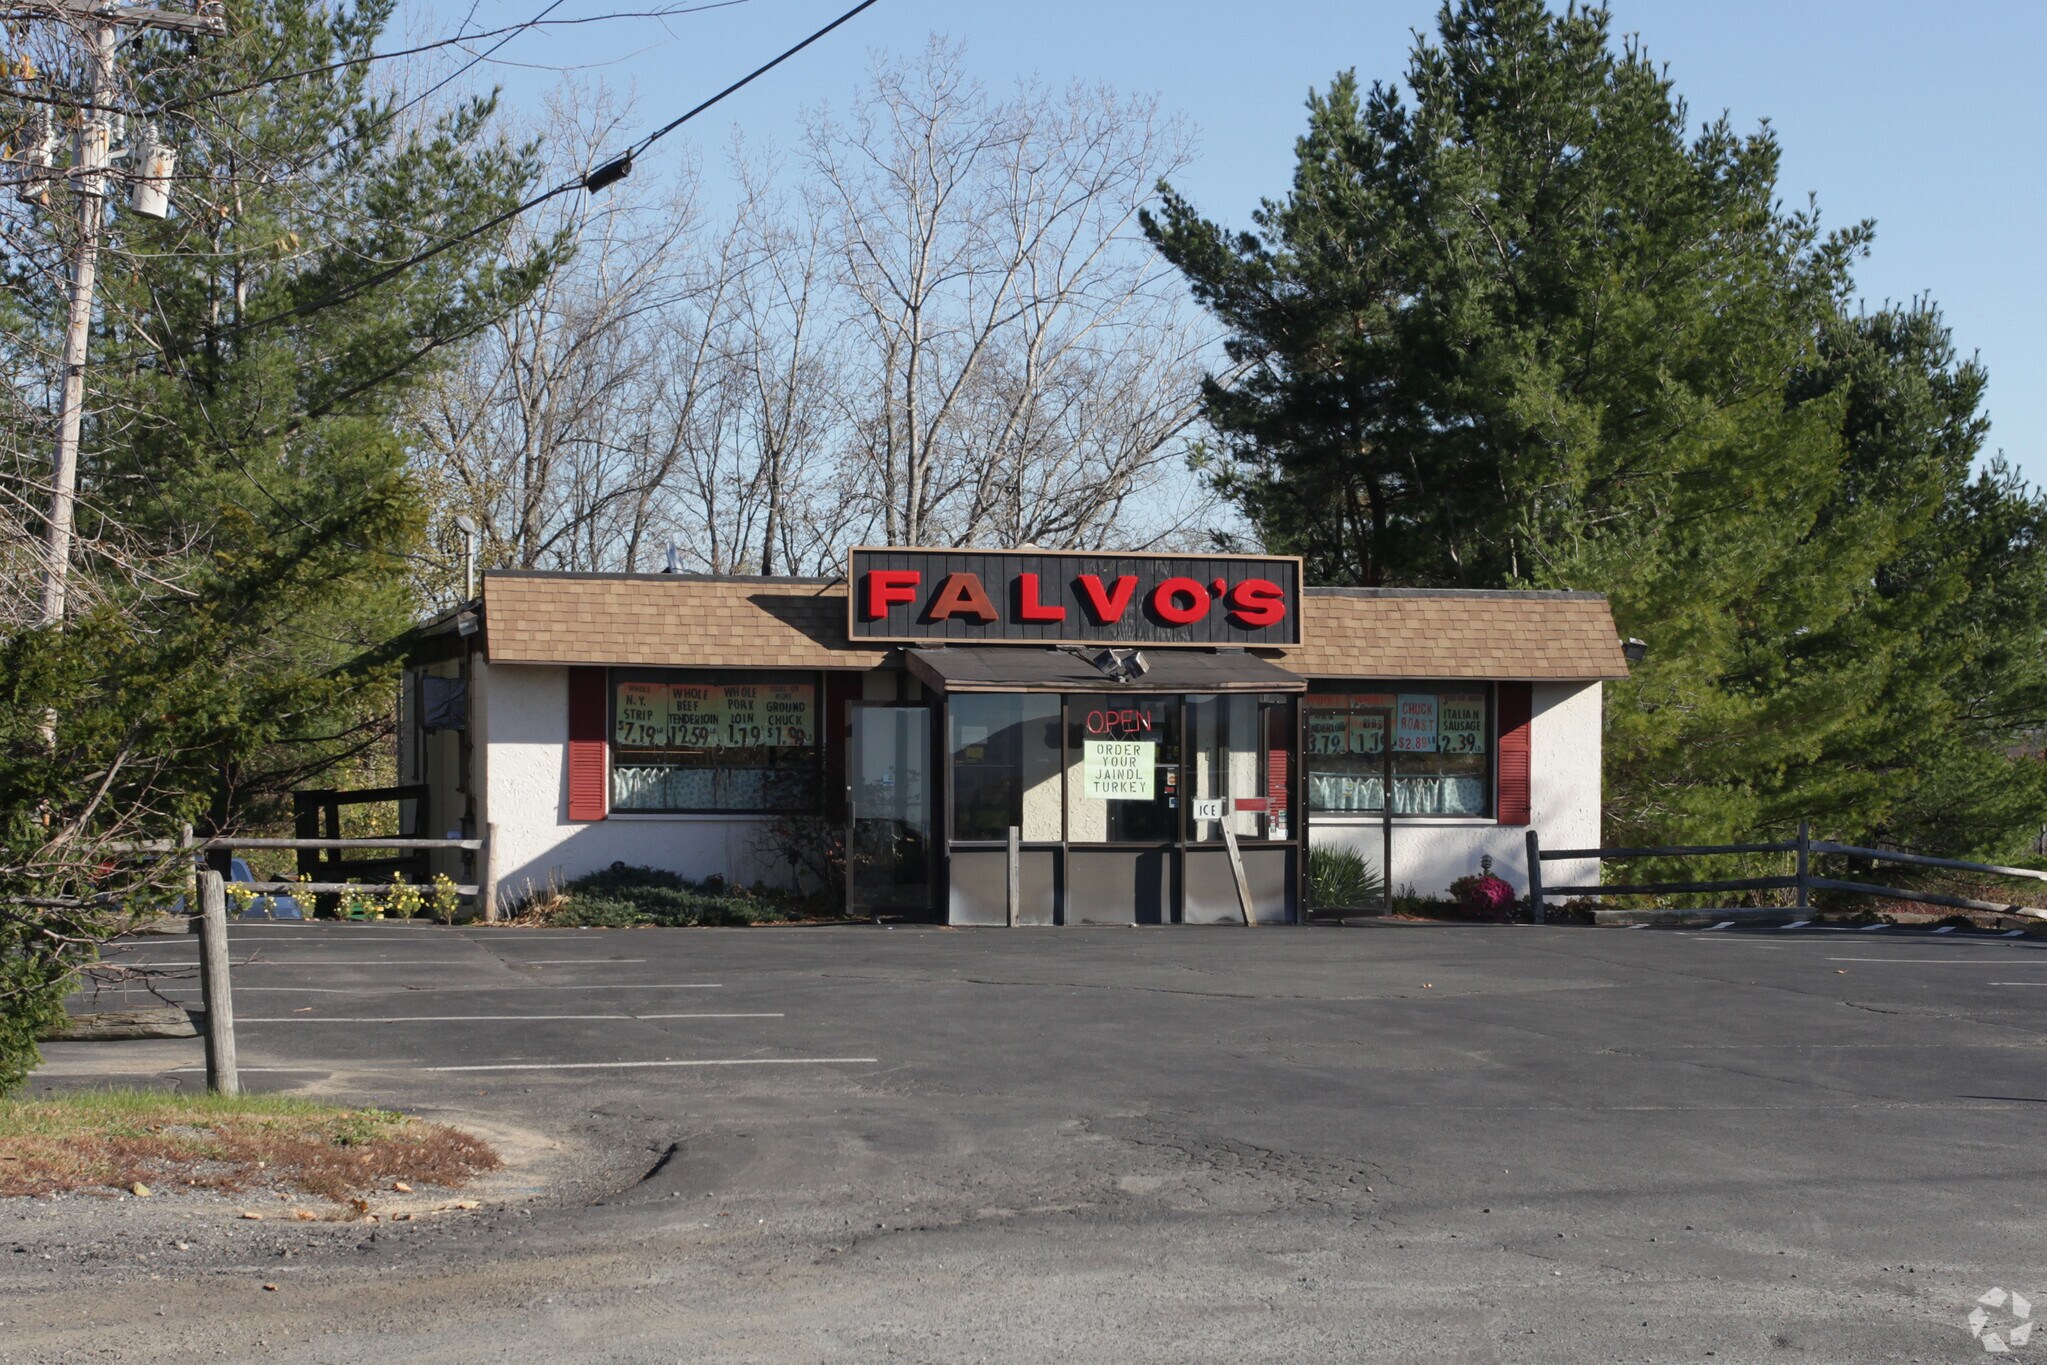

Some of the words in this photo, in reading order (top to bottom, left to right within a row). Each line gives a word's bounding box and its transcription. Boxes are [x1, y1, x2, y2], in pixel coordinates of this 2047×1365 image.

[868, 569, 1286, 627] FALVO'S
[672, 688, 708, 700] WHOLE
[724, 687, 758, 698] WHOLE
[676, 700, 698, 712] BEEF
[728, 699, 754, 710] PORK
[766, 702, 806, 712] GROUND
[1402, 702, 1433, 716] CHUCK
[624, 708, 653, 720] STRIP
[668, 714, 718, 725] TENDERLOIN
[731, 713, 754, 724] LOIN
[768, 714, 802, 726] CHUCK
[1443, 708, 1480, 720] ITALIAN
[1086, 709, 1152, 734] OPEN
[1402, 717, 1434, 732] ROAST
[1443, 720, 1480, 732] SAUSAGE
[1398, 736, 1428, 750] $2.89
[1442, 733, 1476, 753] 2.39
[1096, 744, 1142, 756] ORDER
[1102, 756, 1136, 768] YOUR
[1094, 768, 1143, 780] JAINDL
[1094, 781, 1146, 793] TURKEY
[1199, 804, 1216, 816] ICE
